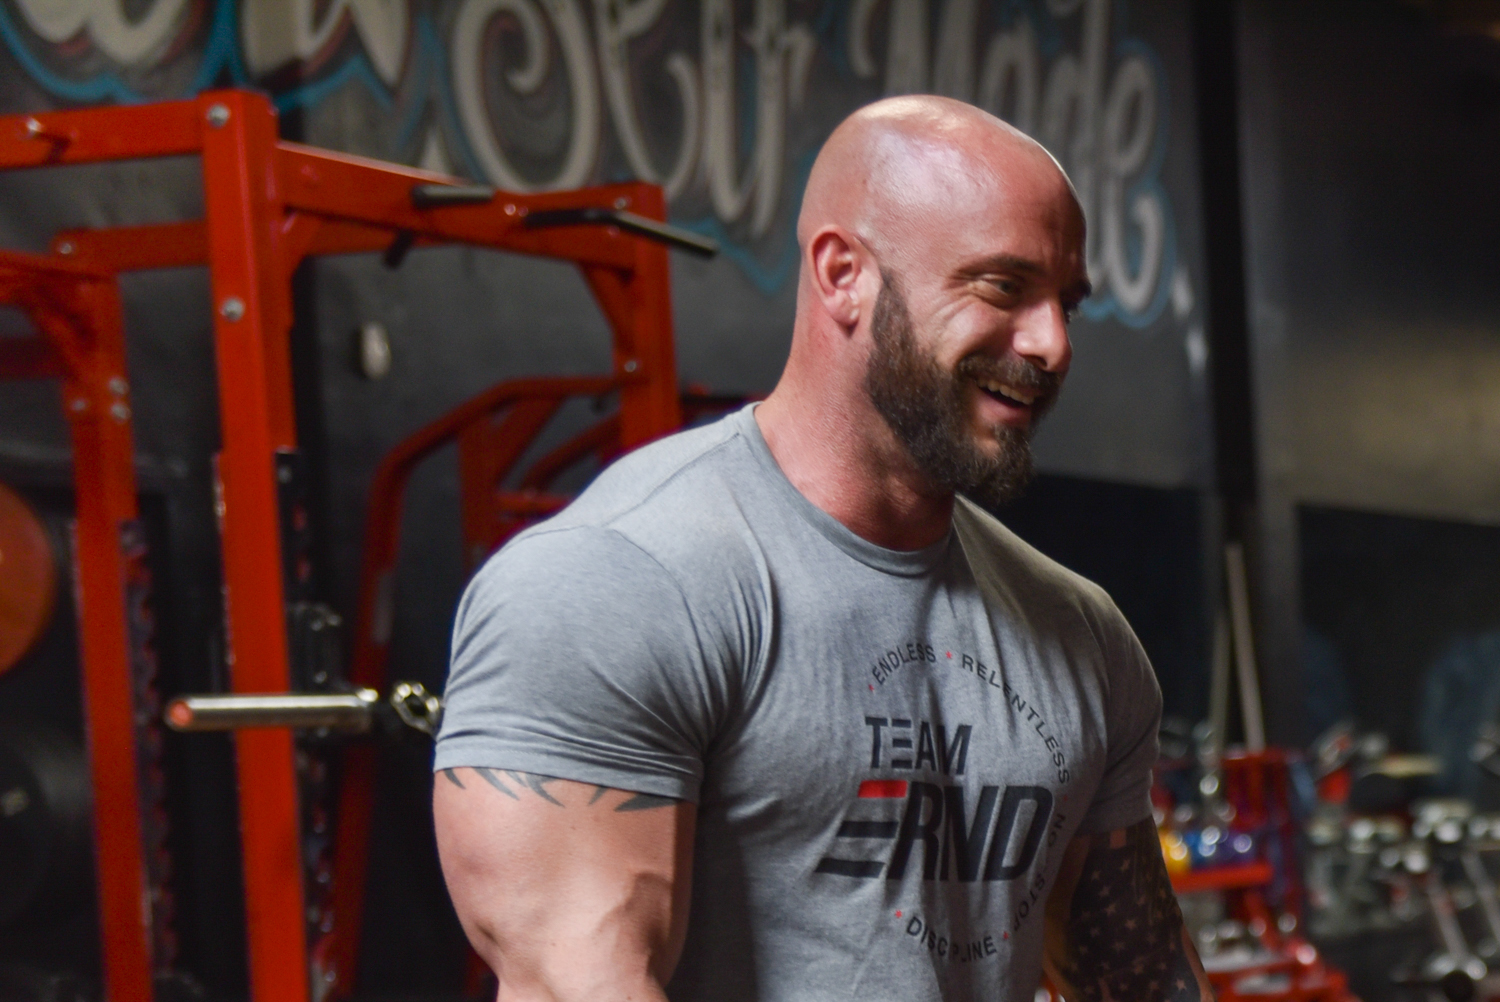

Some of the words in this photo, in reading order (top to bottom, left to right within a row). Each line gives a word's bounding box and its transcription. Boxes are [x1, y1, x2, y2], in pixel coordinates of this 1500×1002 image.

[871, 643, 937, 686] ENDLESS
[864, 715, 973, 776] TEAM
[961, 653, 1070, 785] RELENTLESS
[905, 915, 997, 963] DISCPINE
